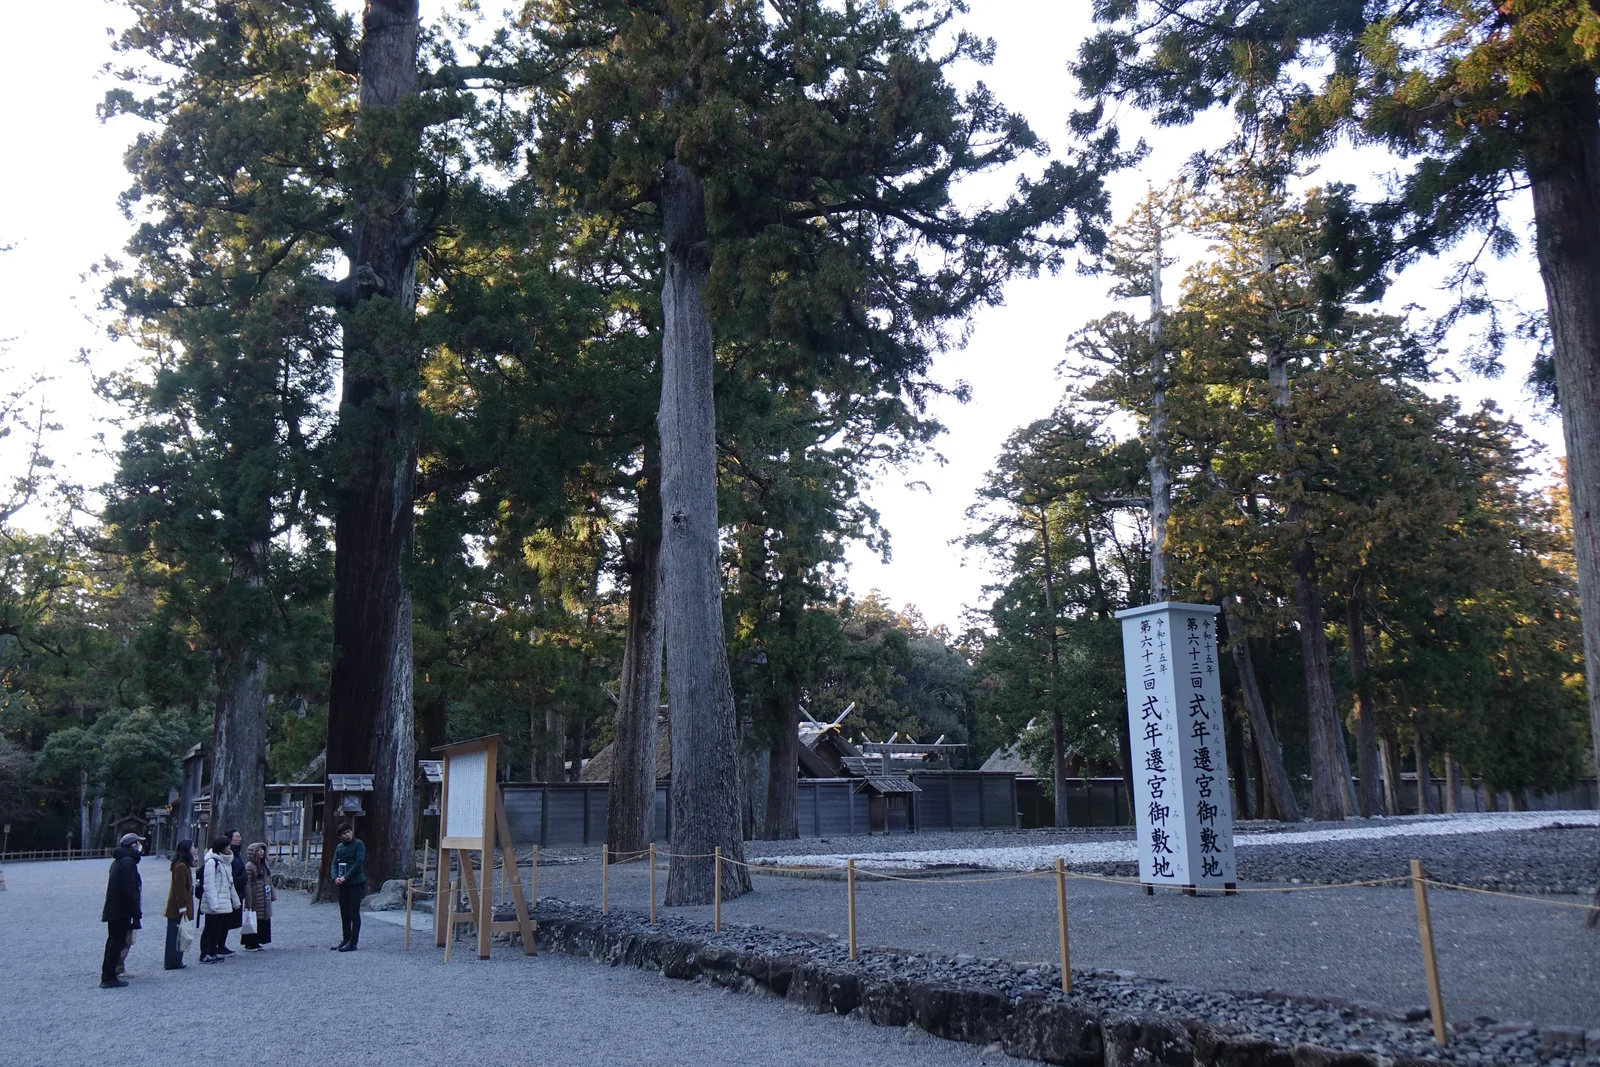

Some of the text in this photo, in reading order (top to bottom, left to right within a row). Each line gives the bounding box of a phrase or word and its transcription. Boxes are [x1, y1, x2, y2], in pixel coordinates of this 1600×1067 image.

[1156, 617, 1168, 675] 令和十五年
[1202, 619, 1214, 676] 令和十五年
